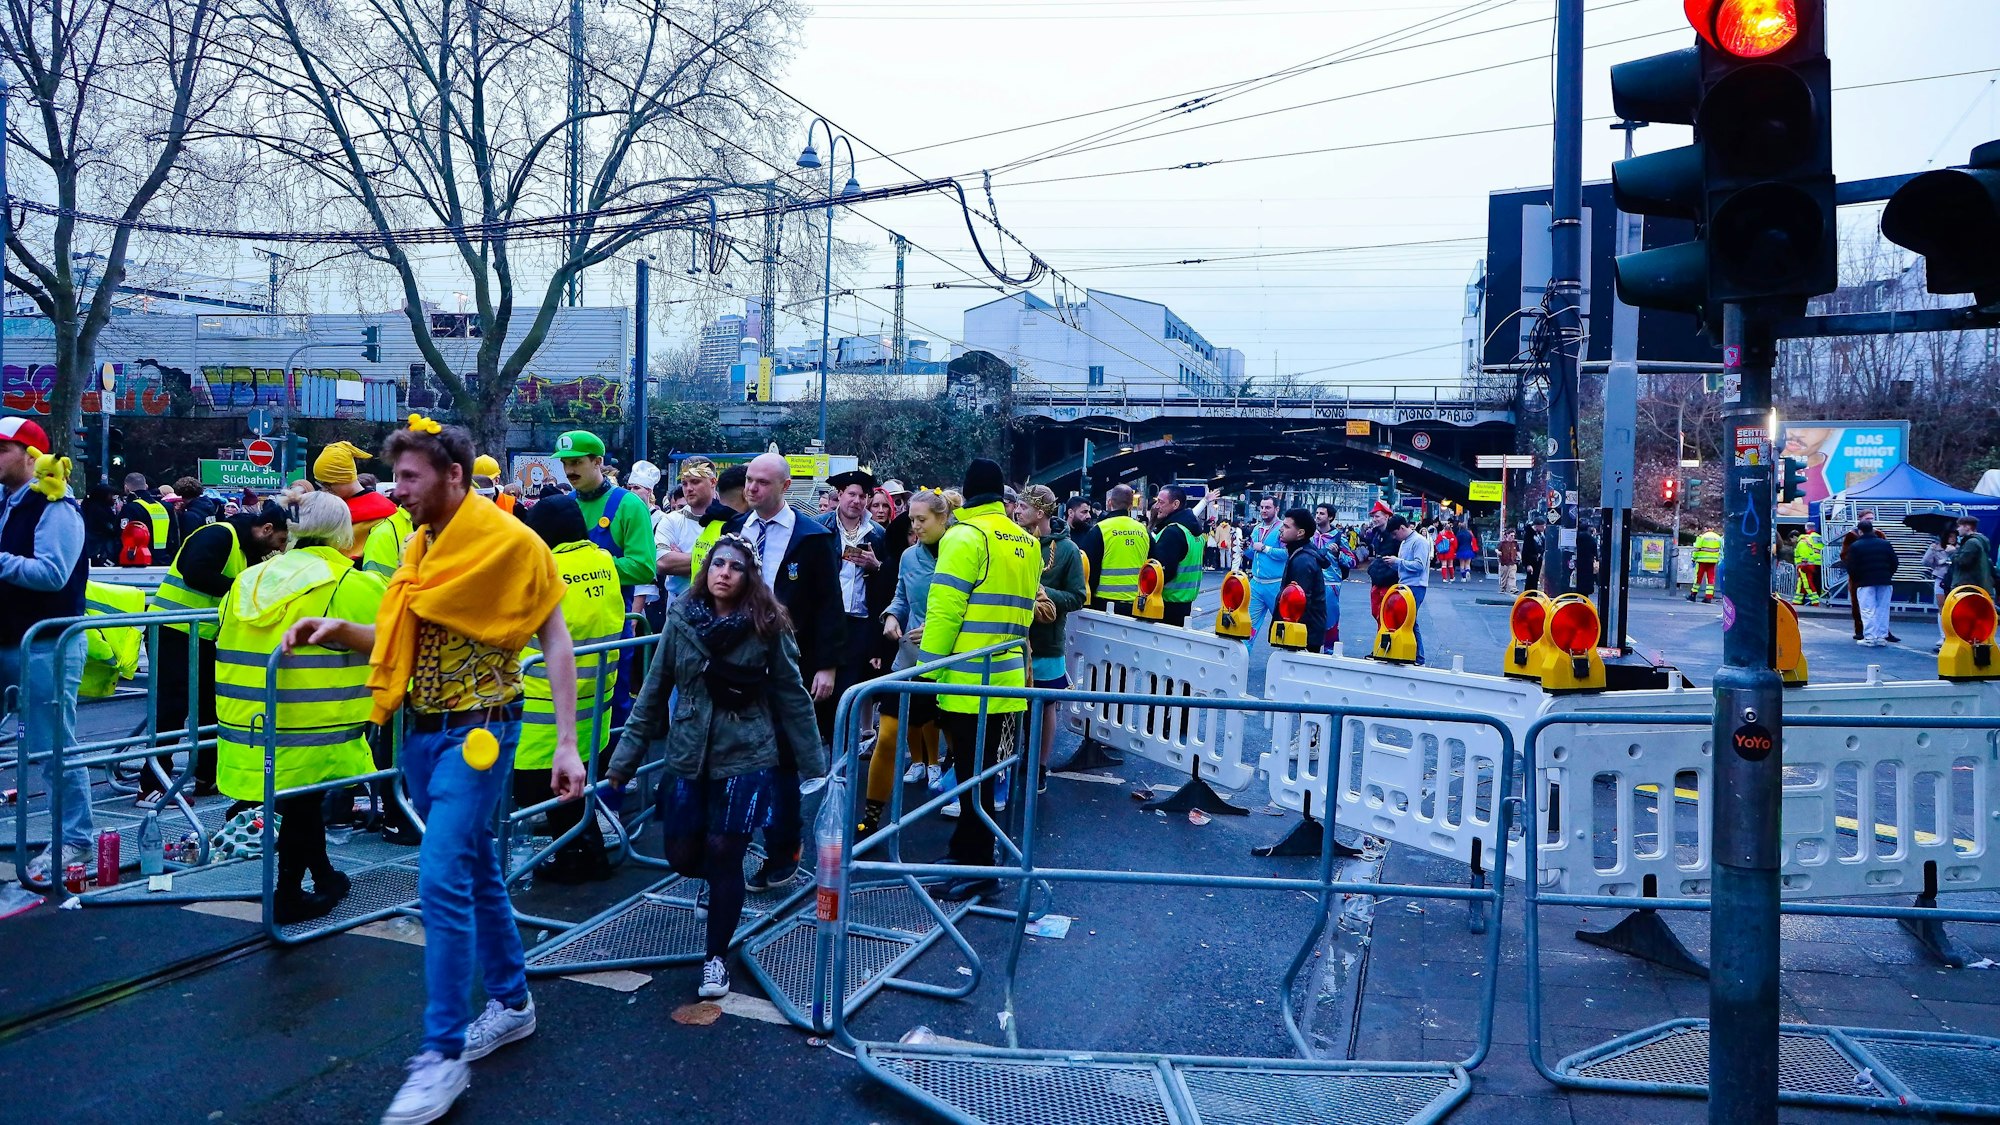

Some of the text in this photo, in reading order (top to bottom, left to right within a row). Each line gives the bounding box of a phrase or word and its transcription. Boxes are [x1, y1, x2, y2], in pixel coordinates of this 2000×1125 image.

[1315, 408, 1345, 419] MONO
[1398, 408, 1474, 423] MONO PABLO
[1856, 434, 1884, 445] DAS
[1844, 446, 1896, 457] BRINGT
[220, 463, 239, 472] nur
[1854, 458, 1884, 468] NUR
[222, 474, 288, 485] Südbahnh
[1111, 528, 1144, 538] Security
[993, 530, 1034, 548] Security
[1125, 538, 1135, 546] 85
[1014, 547, 1025, 559] 40
[562, 568, 612, 585] Security
[584, 585, 605, 598] 137
[1735, 734, 1771, 750] YoYo
